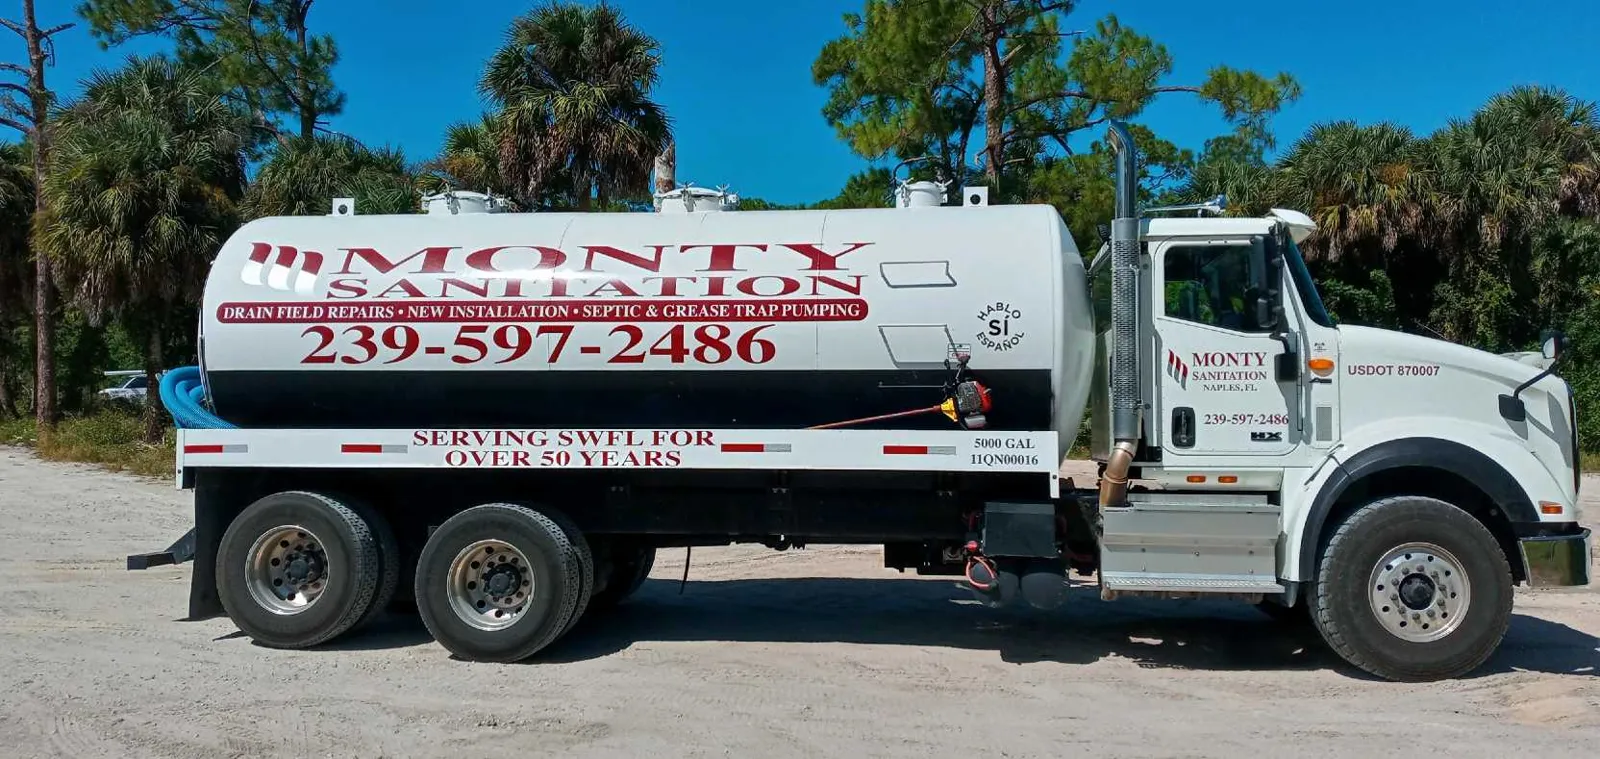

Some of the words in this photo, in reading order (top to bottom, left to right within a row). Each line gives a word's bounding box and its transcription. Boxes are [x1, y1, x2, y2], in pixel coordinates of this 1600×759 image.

[328, 242, 876, 275] MONTY
[326, 275, 869, 299] SANITATION
[223, 306, 274, 319] DRAIN
[276, 306, 324, 319] FIELD
[328, 305, 395, 319] REPAIRS
[407, 305, 446, 318] NEW
[448, 305, 569, 318] INSTALLATION
[582, 304, 642, 318] SEPTIC
[645, 304, 659, 318] &
[663, 304, 730, 318] GREASE
[733, 304, 778, 317] TRAP
[782, 303, 861, 317] PUMPING
[977, 302, 1022, 321] HABLO
[988, 315, 1010, 336] SÍ
[300, 324, 776, 365] 239-597-2486
[976, 331, 1025, 352] ESPAÑOL
[1192, 352, 1268, 367] MONTY
[1192, 371, 1267, 381] SANITATION
[1348, 365, 1394, 376] USDOT
[1397, 365, 1440, 376] 870007
[1203, 384, 1244, 392] NAPLES,
[1245, 384, 1258, 392] FL
[1204, 413, 1289, 425] 239-597-2486
[412, 430, 550, 447] SERVING
[558, 430, 643, 447] SWFL
[650, 430, 716, 446] FOR
[974, 438, 1002, 449] 5000
[1005, 438, 1036, 449] GAL
[1250, 431, 1282, 442] HX
[445, 450, 531, 467] OVER
[541, 450, 571, 467] 50
[578, 450, 682, 467] YEARS
[970, 453, 1039, 467] 11QN00016
